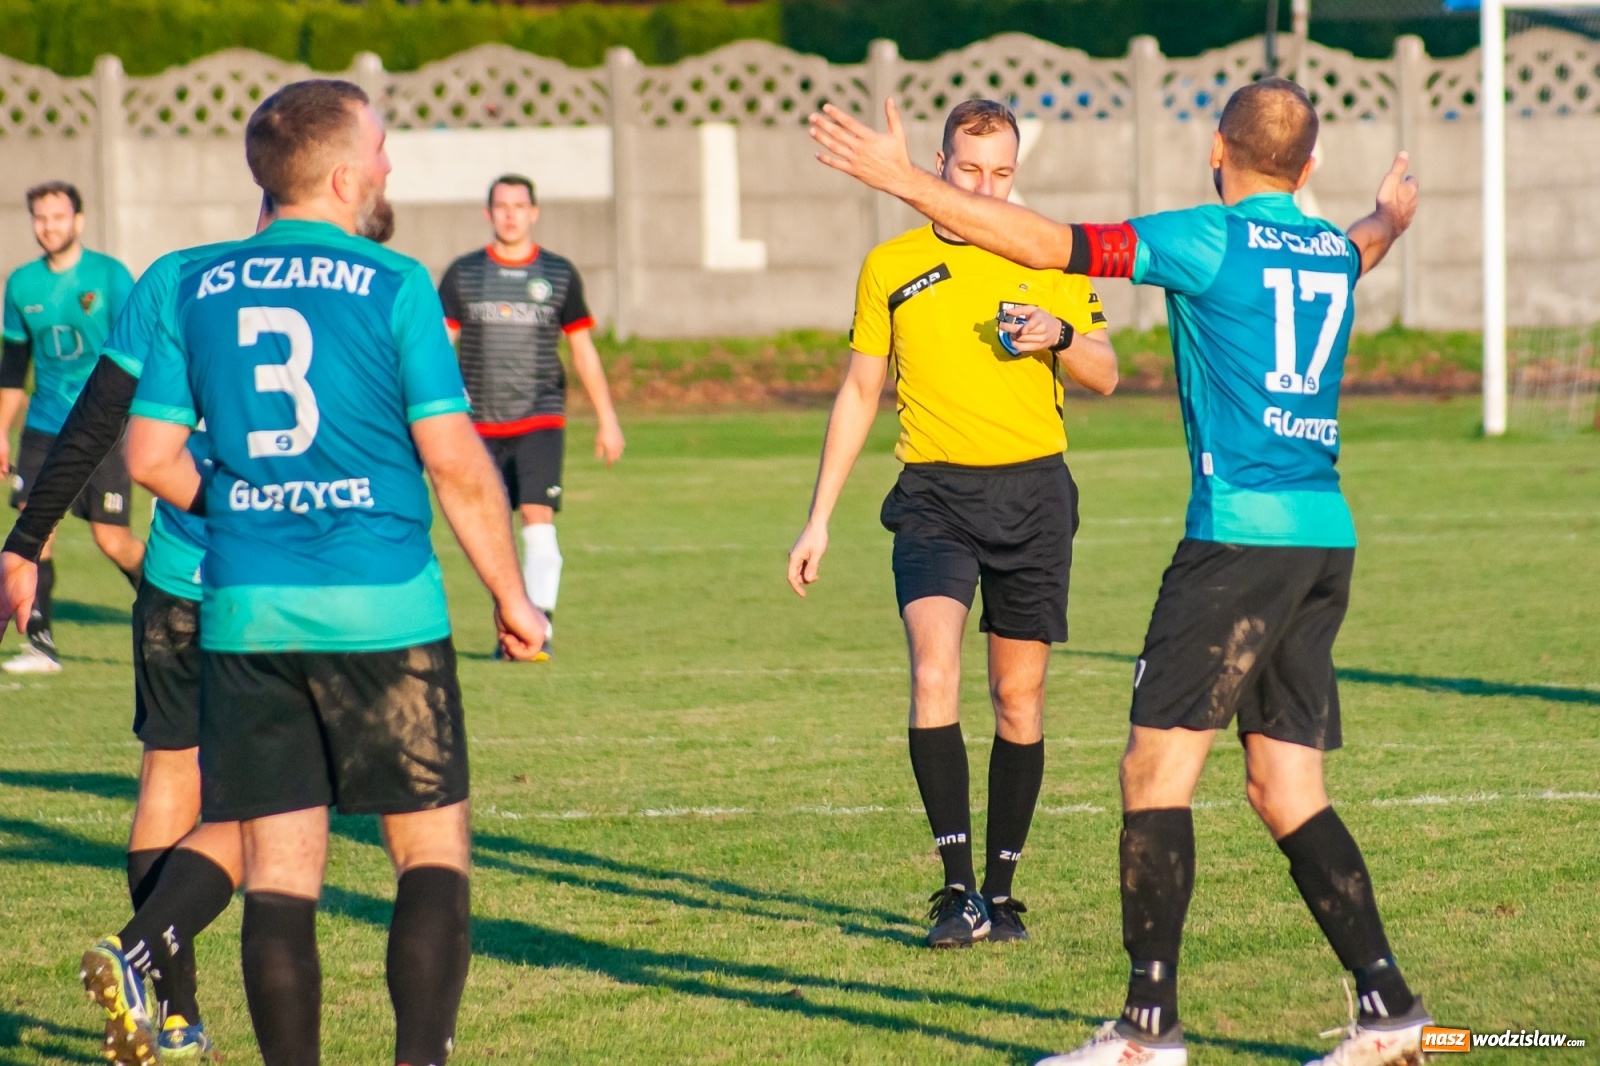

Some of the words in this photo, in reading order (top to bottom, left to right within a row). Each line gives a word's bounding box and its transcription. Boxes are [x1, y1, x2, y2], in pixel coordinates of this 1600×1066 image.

[1247, 221, 1283, 250] KS
[196, 260, 236, 299] KS
[241, 256, 377, 296] CZARNI
[1263, 267, 1349, 395] 17
[237, 306, 320, 458] 3
[935, 832, 967, 847] zina
